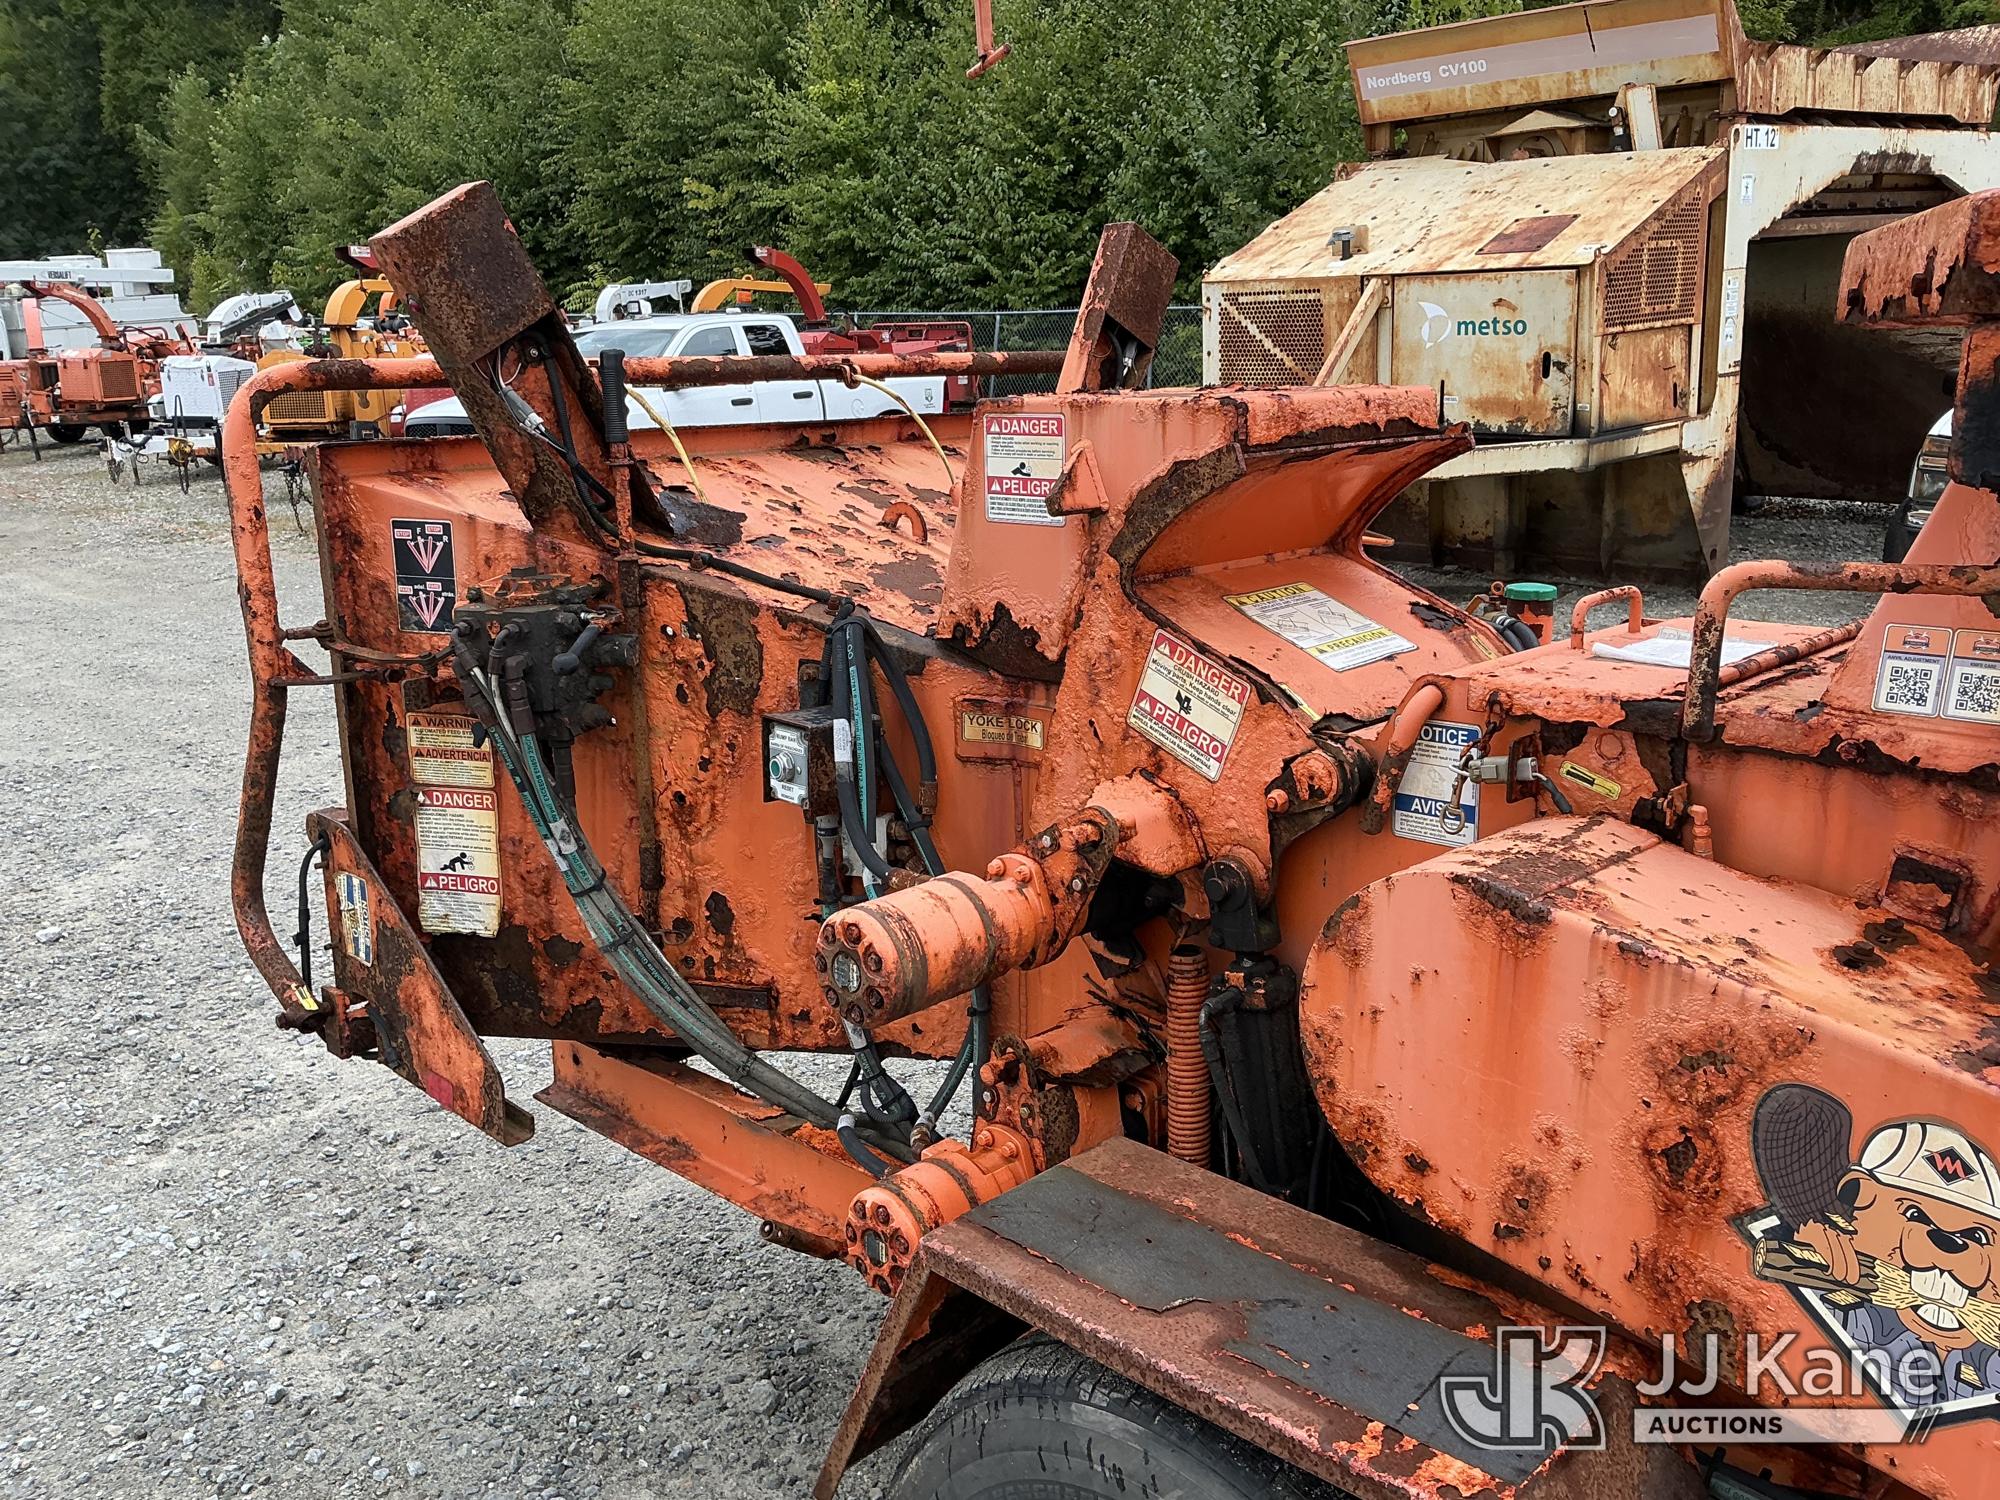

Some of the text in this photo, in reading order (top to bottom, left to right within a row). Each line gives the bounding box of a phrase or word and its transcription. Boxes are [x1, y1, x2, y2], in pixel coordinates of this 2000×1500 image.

[1366, 60, 1487, 90] Nordberg CV100
[1745, 129, 1762, 148] HT.
[233, 302, 249, 317] DRM
[1456, 316, 1528, 336] metso
[1001, 419, 1058, 435] DANGER
[416, 527, 422, 535] F
[442, 535, 449, 543] R
[1246, 585, 1306, 604] CAUTION
[1173, 646, 1243, 702] DANGER
[1173, 664, 1220, 697] CRUSH HAZARD
[1151, 657, 1172, 678] Moving
[1188, 679, 1204, 697] Keep
[1203, 688, 1221, 708] hands
[1221, 700, 1238, 717] clear.
[425, 715, 474, 728] WARNIN
[967, 714, 1039, 733] YOKE LOCK
[1152, 702, 1222, 758] PELIGRO
[1418, 725, 1469, 746] OTICE
[425, 748, 488, 761] ADVERTENCIA
[432, 791, 493, 809] DANGER
[438, 875, 498, 894] PELIGRO
